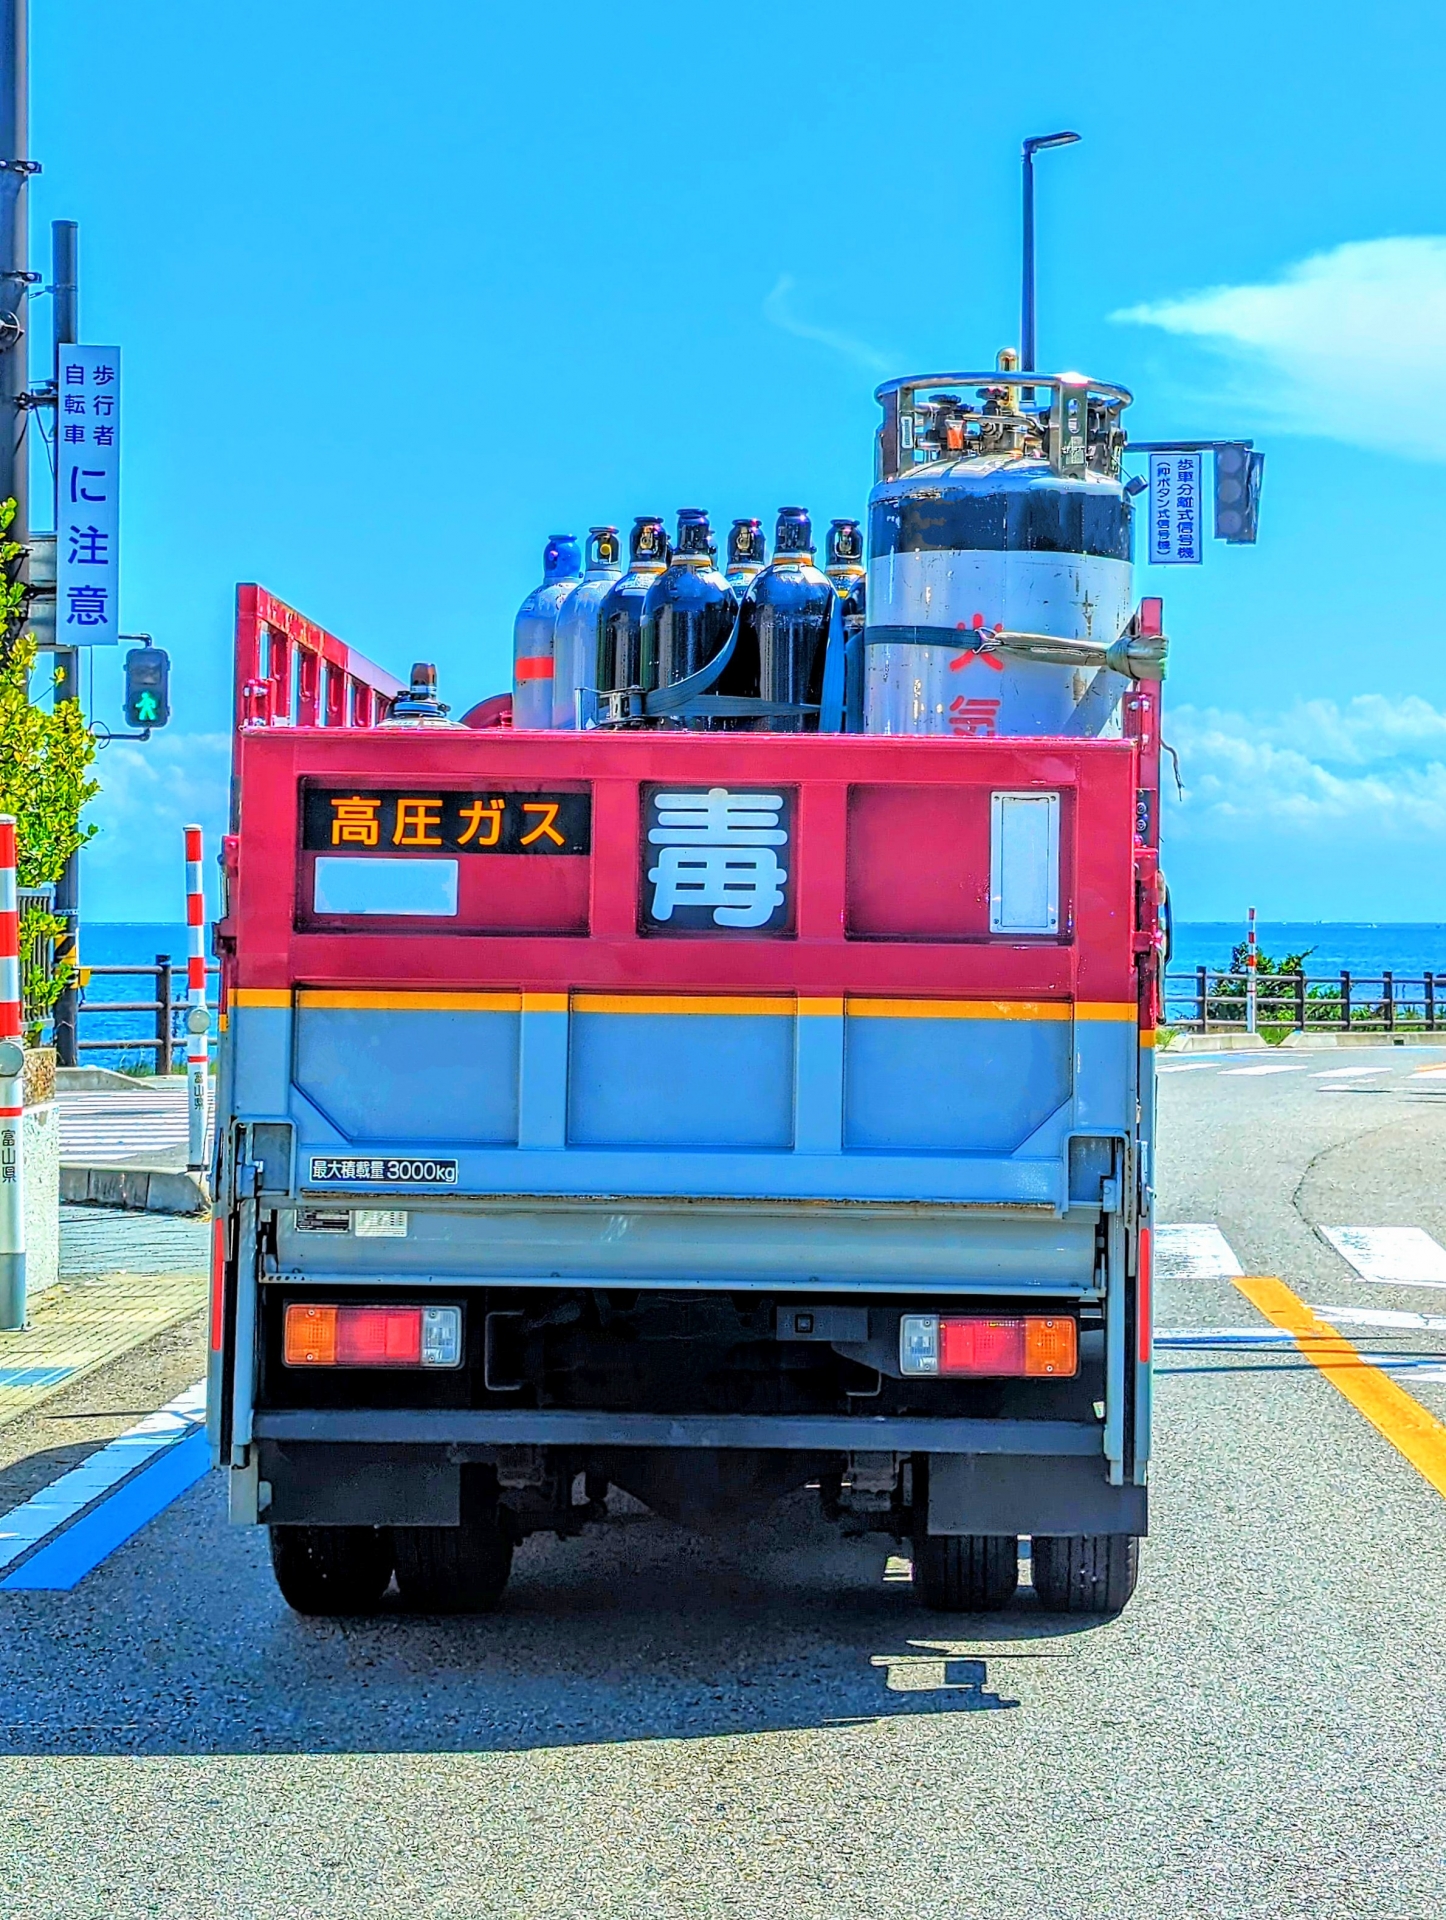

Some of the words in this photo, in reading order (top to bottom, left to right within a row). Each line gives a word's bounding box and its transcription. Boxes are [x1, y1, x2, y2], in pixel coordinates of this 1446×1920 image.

[63, 363, 86, 445] 自転車
[92, 364, 115, 447] 歩行者
[66, 465, 109, 626] に注意
[1176, 458, 1195, 559] 歩車分離式信号機
[330, 795, 566, 848] 高圧ガス
[647, 787, 788, 928] 毒
[1, 1128, 17, 1184] 富山県
[312, 1160, 456, 1182] 最大積載量3000kg
